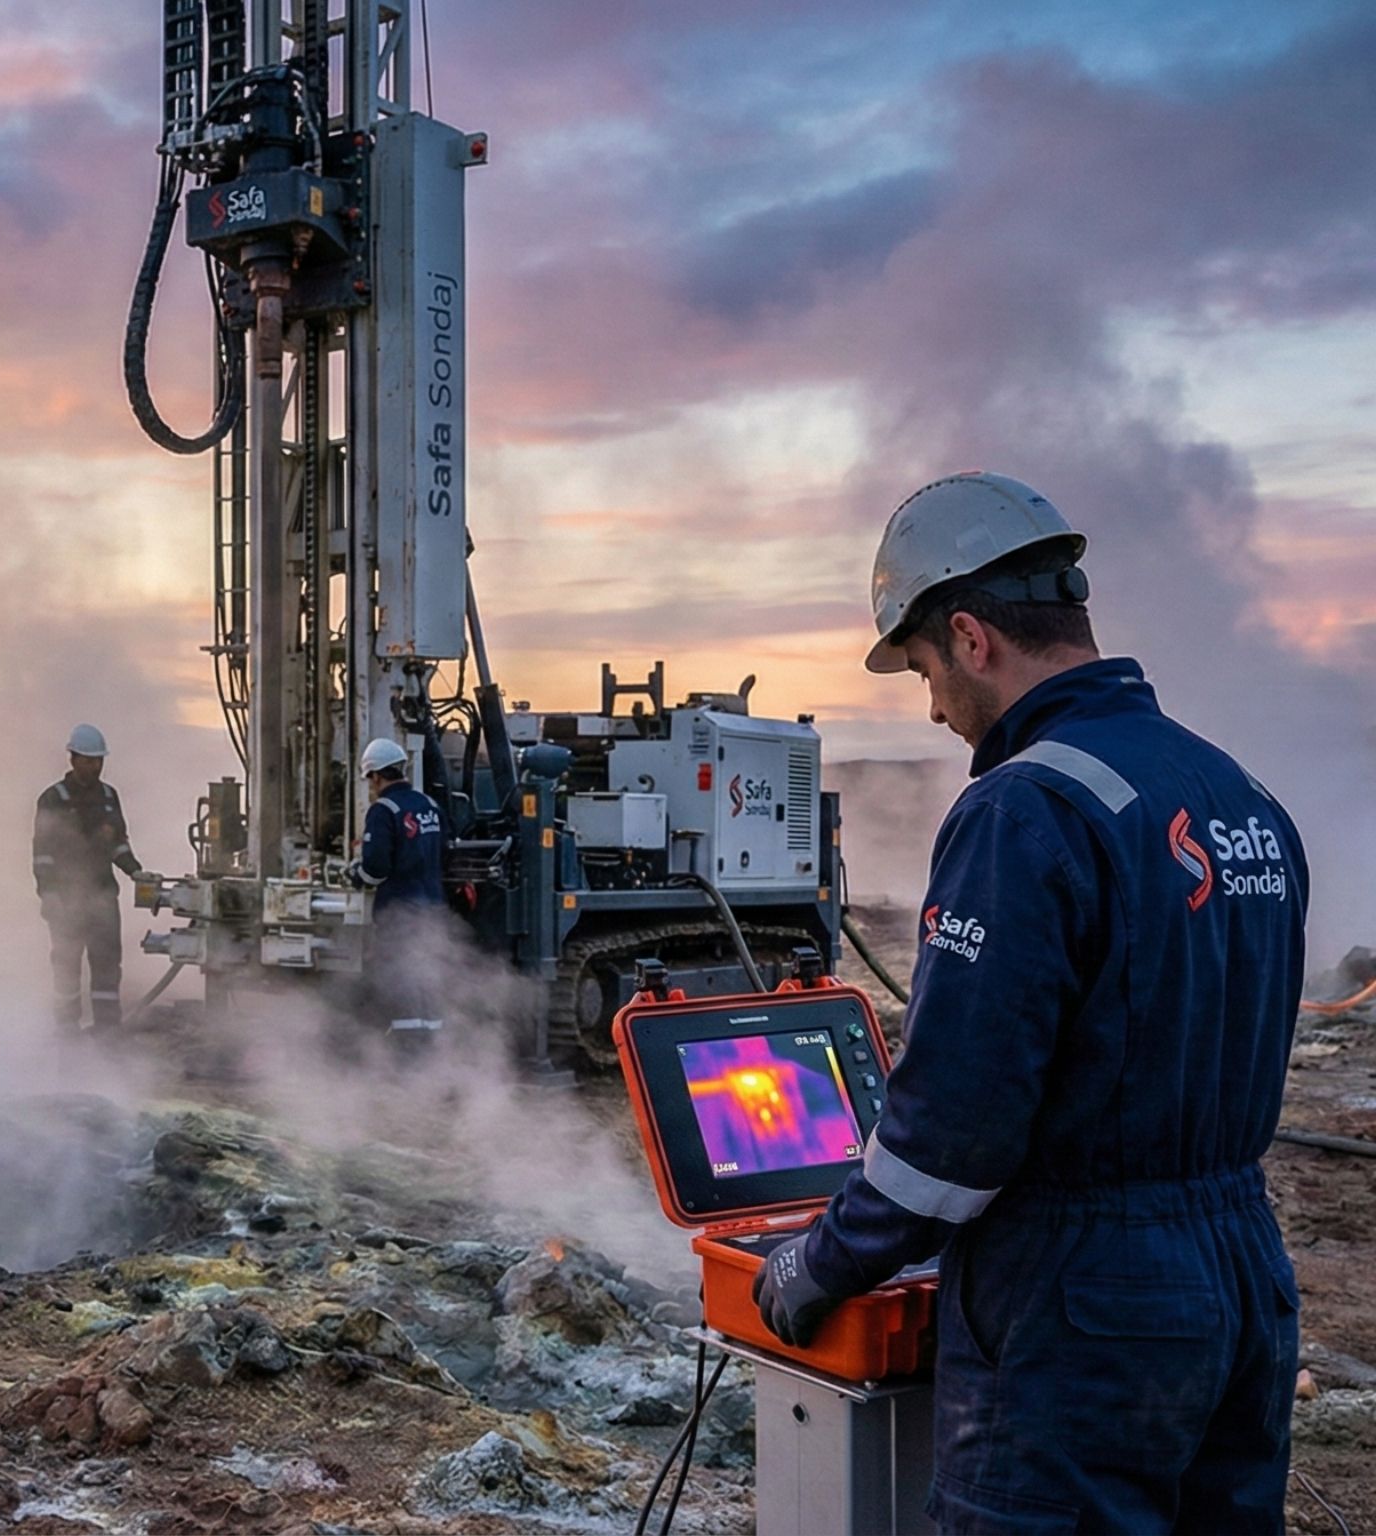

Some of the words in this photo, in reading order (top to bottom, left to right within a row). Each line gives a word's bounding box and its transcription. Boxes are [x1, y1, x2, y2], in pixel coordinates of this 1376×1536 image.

[228, 186, 264, 210] Safa
[427, 271, 458, 408] Sondaj
[427, 422, 452, 517] Safa
[745, 779, 771, 800] Safa
[1209, 816, 1281, 861] Safa
[1222, 866, 1286, 901] Sondaj
[939, 911, 985, 943] Safa
